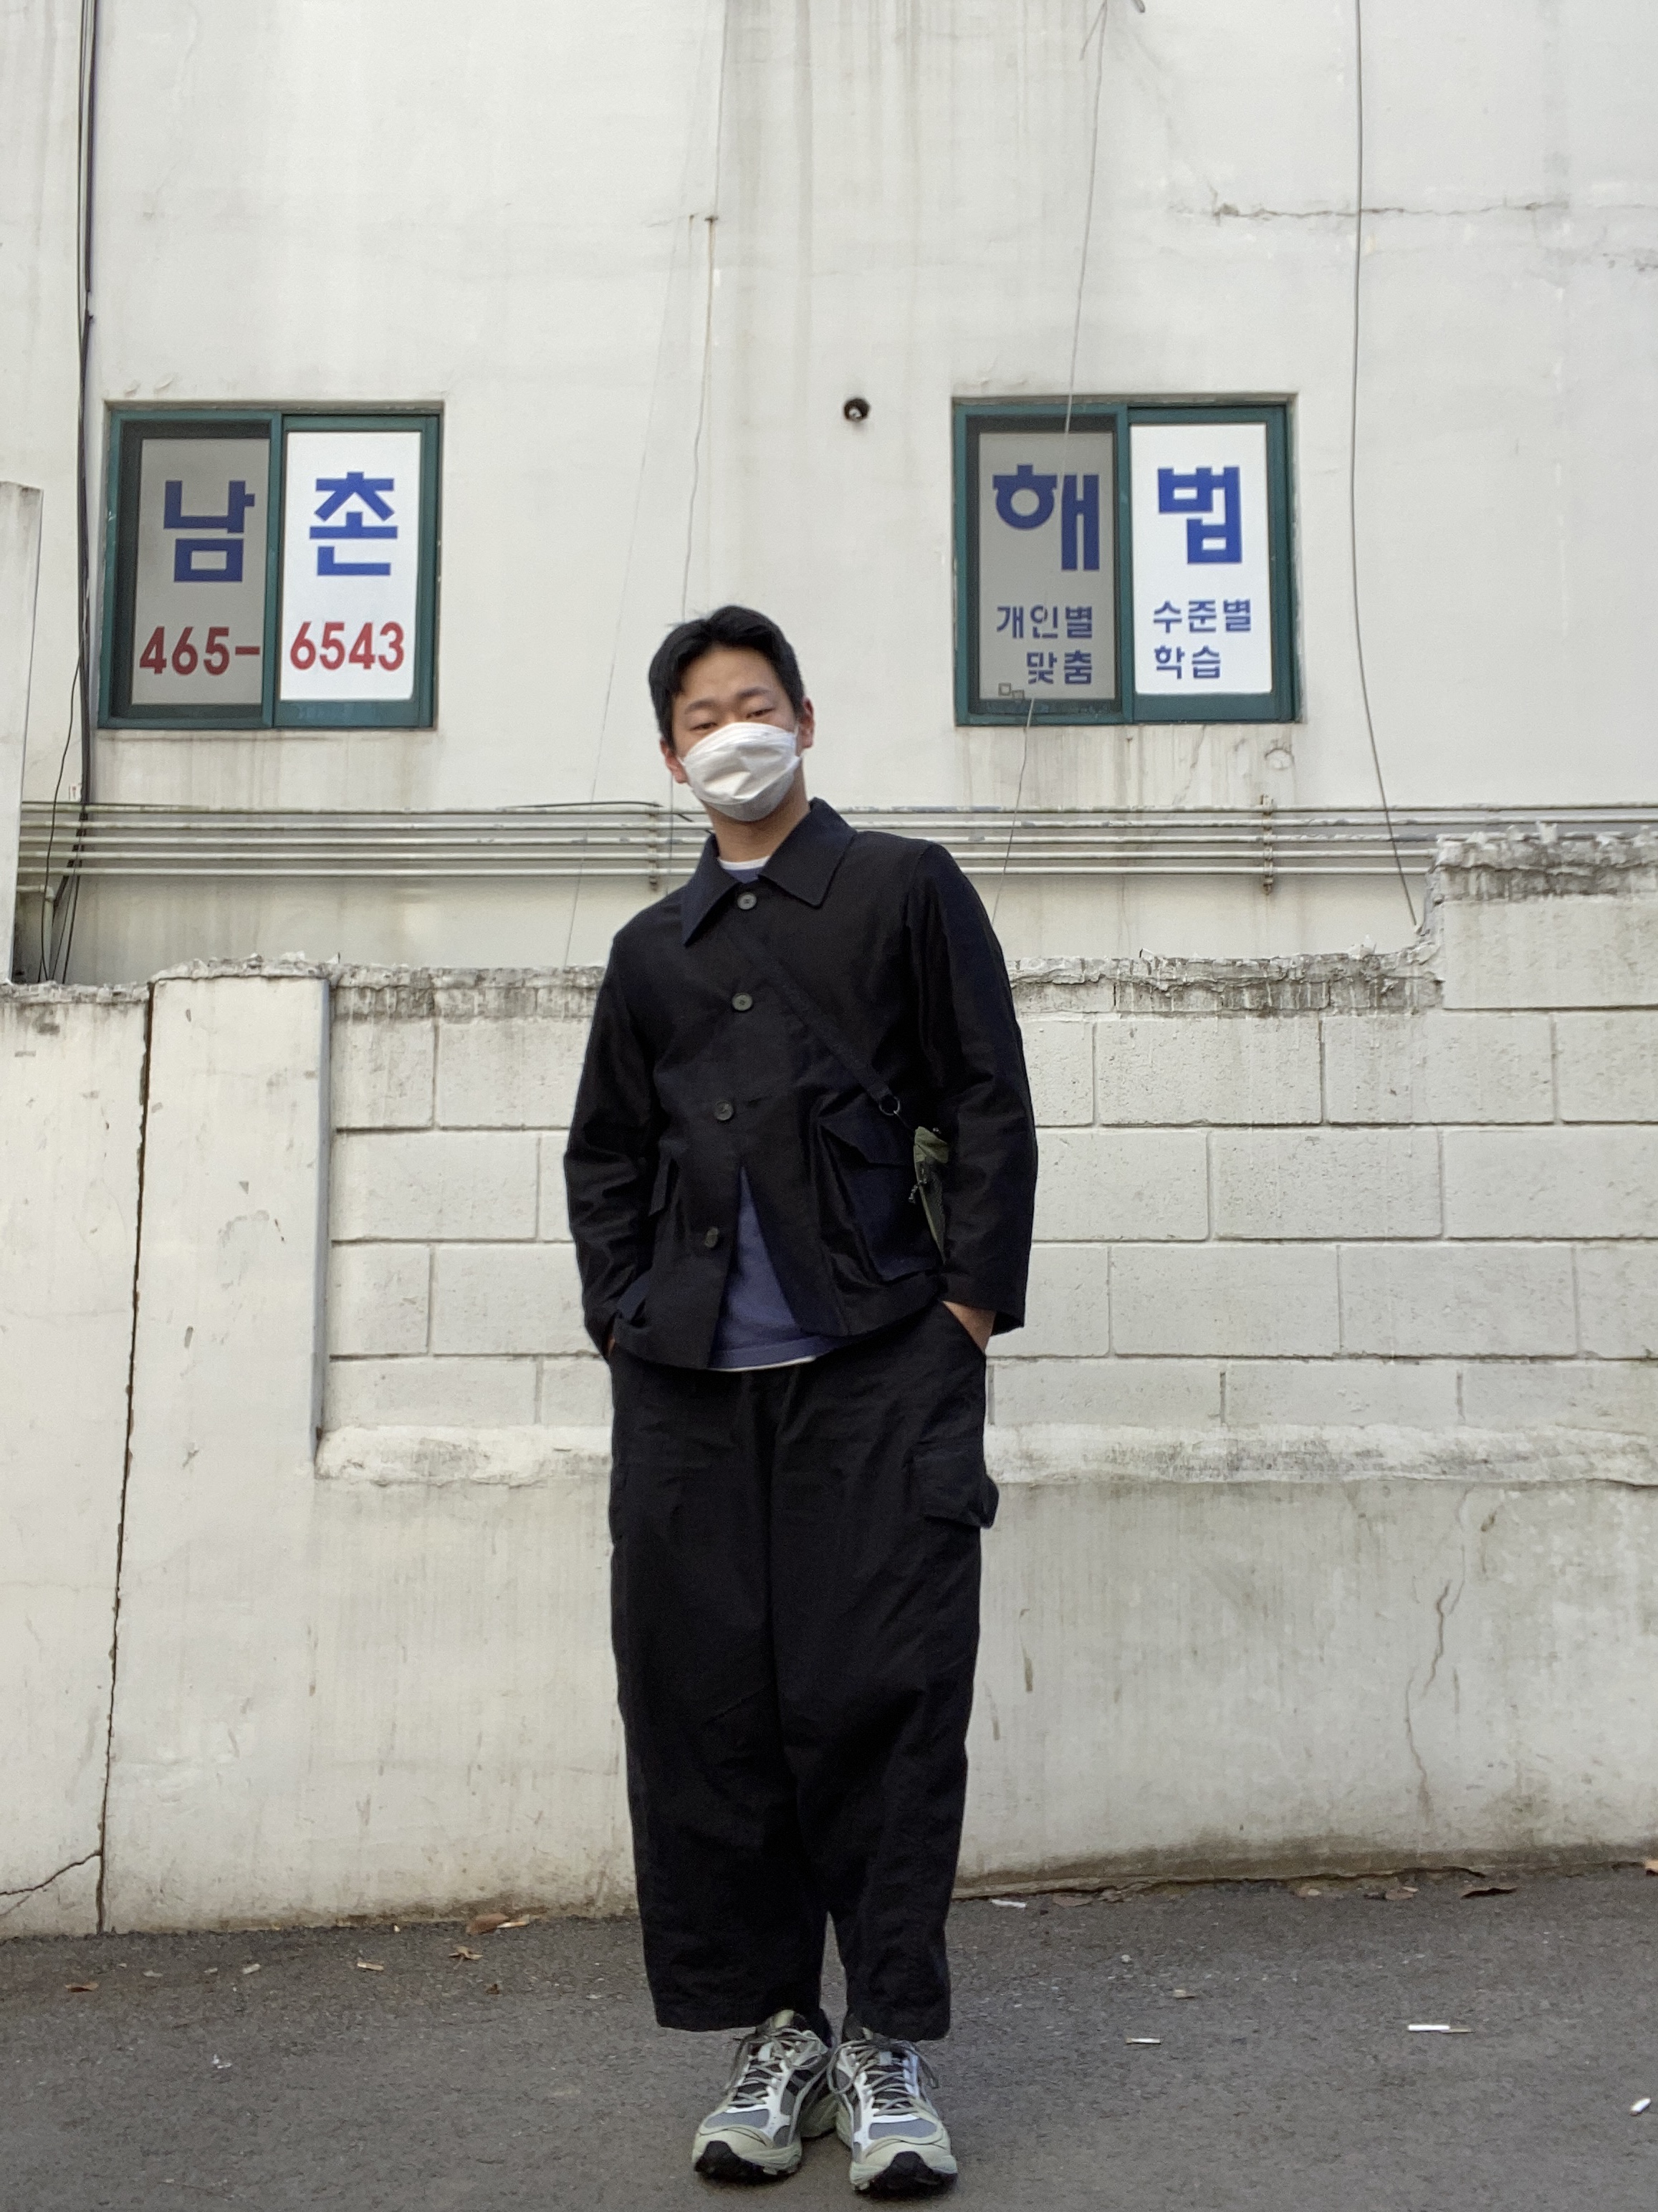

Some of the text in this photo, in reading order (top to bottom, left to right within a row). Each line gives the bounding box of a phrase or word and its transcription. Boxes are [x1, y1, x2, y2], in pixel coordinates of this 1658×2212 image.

[997, 605, 1093, 638] 개인별
[1153, 598, 1252, 634] 수준별
[1027, 650, 1092, 684] 맞춤
[1154, 645, 1221, 680] 학습
